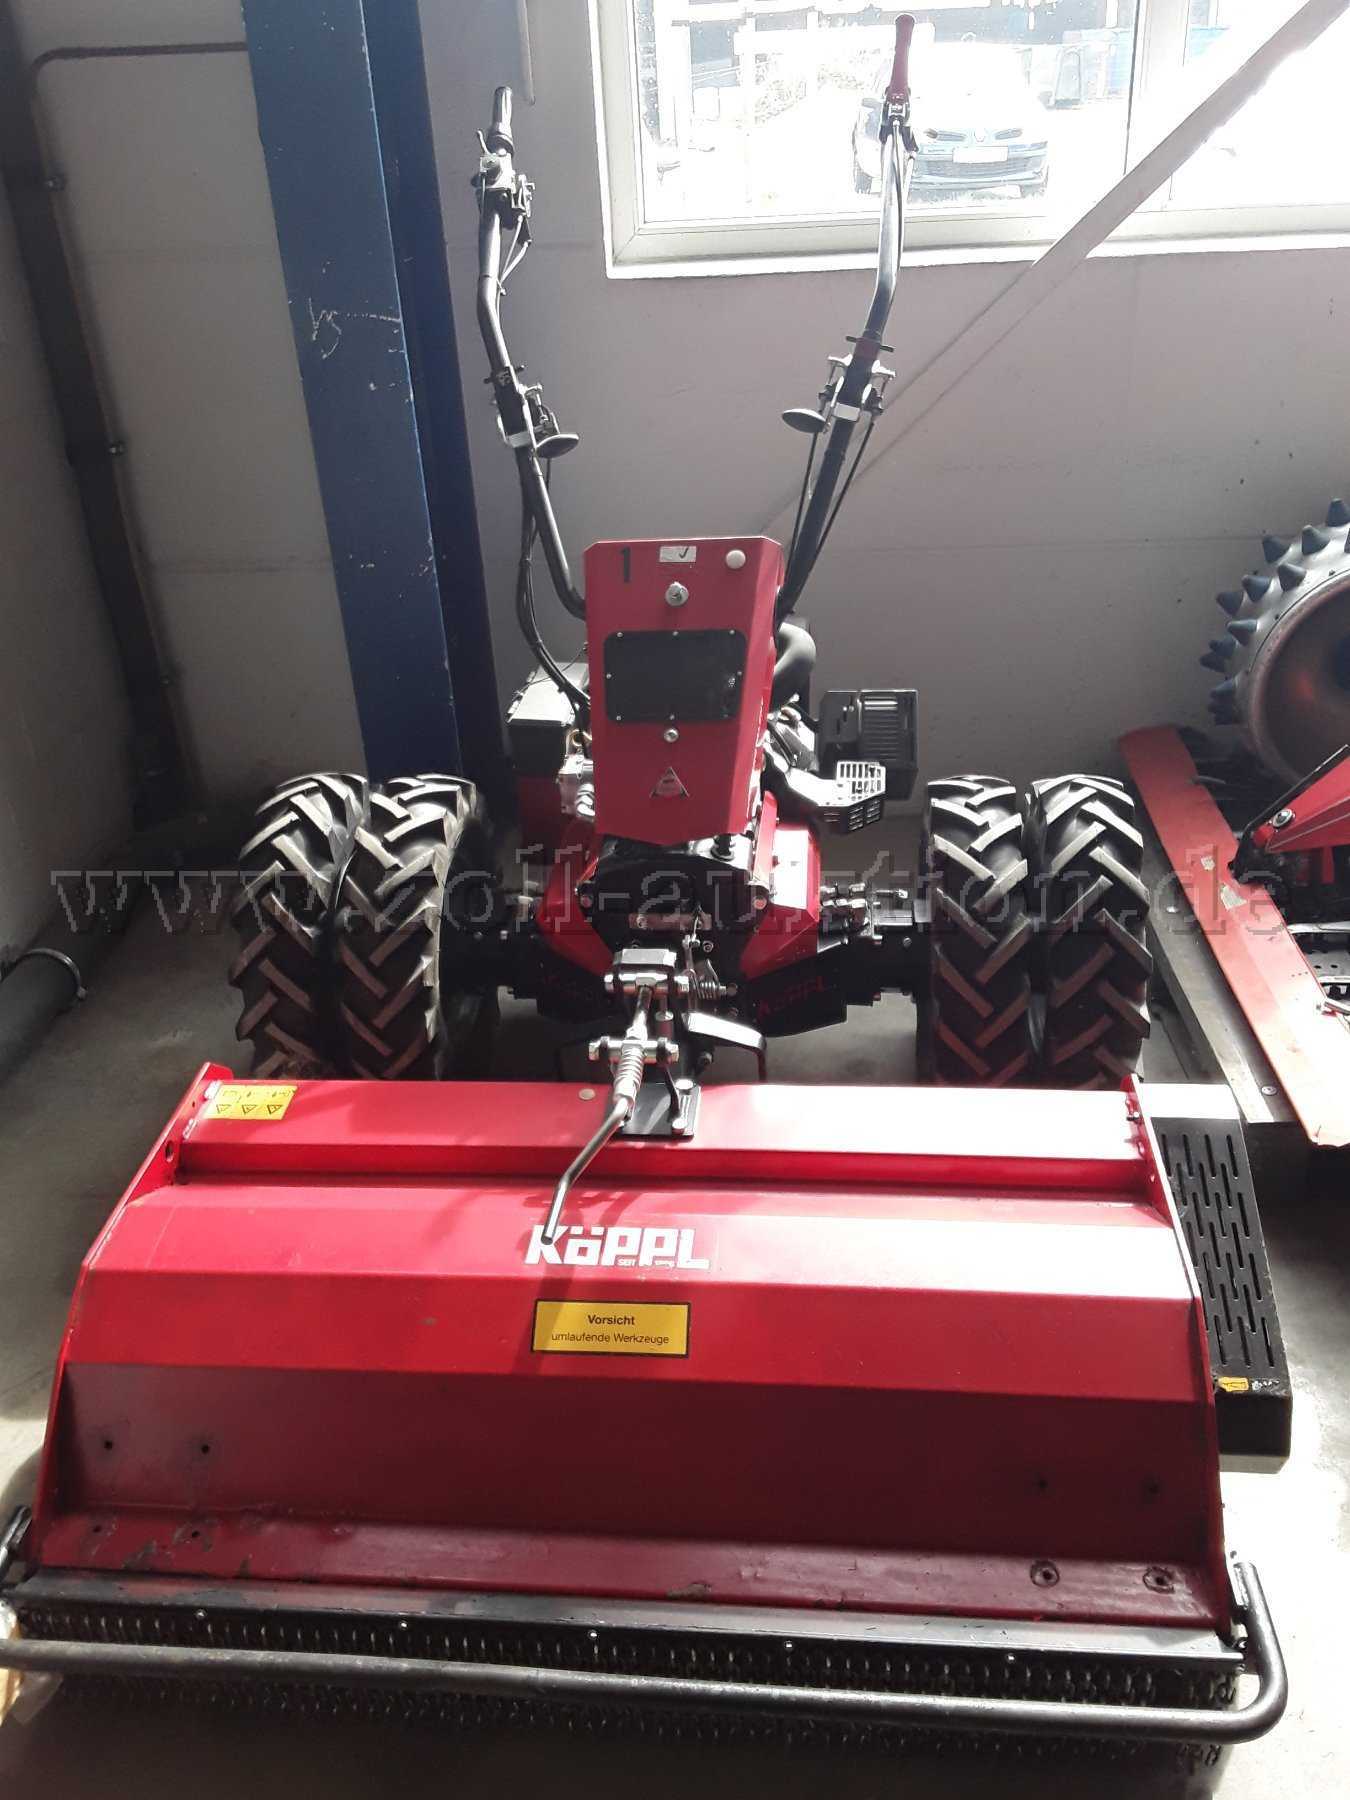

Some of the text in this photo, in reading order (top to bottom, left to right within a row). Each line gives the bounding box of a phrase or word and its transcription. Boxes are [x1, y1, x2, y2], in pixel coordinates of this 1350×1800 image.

[617, 545, 632, 584] 1
[588, 1314, 635, 1326] Vorsicht
[551, 1331, 670, 1346] umlaufende Werkzeuge
